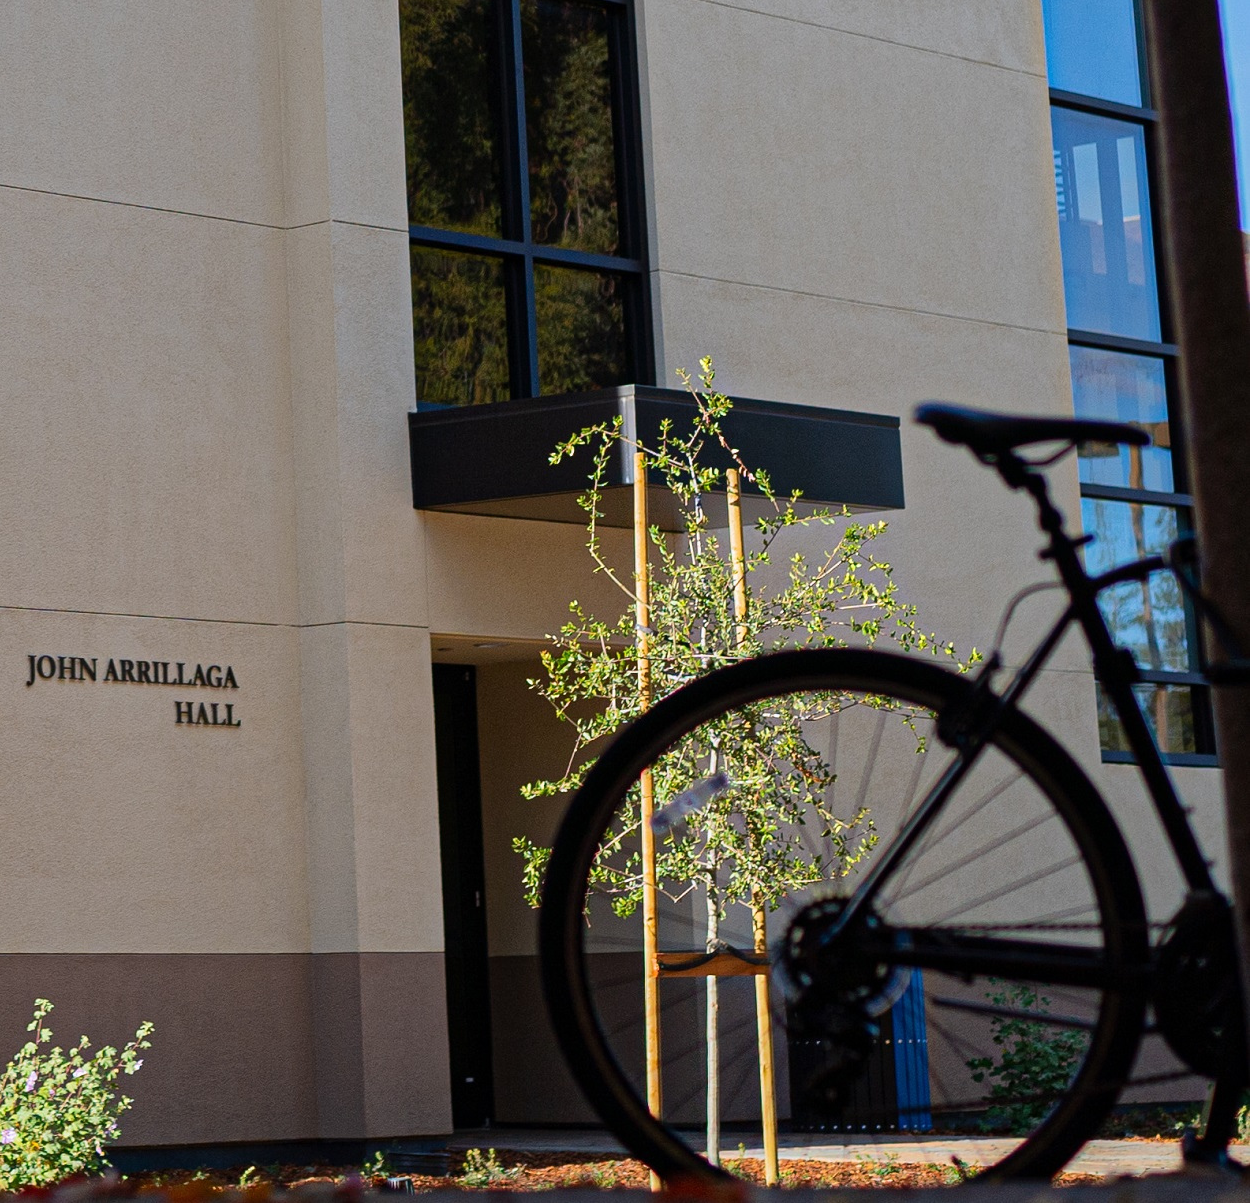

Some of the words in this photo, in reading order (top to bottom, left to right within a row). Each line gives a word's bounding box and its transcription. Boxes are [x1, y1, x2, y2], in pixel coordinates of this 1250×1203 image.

[26, 654, 98, 686] JOHN
[103, 658, 240, 689] ARRILLAGA
[174, 701, 241, 727] HALL
